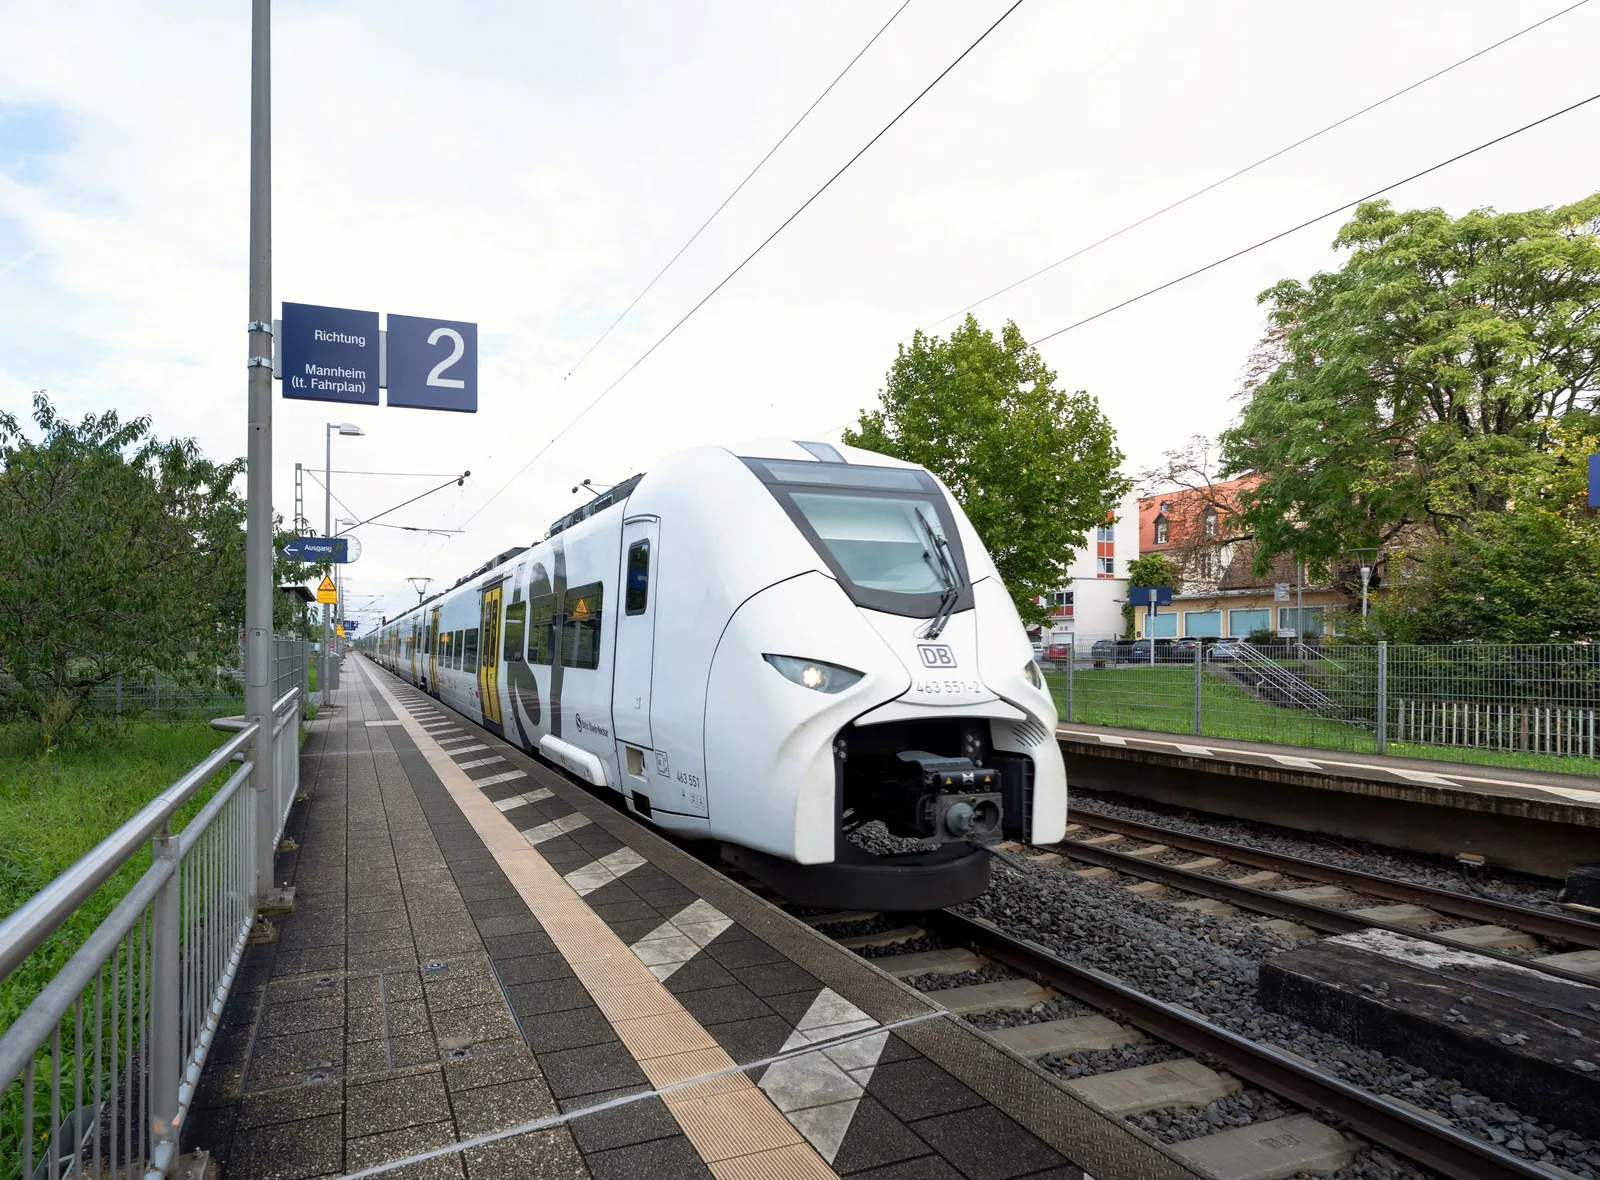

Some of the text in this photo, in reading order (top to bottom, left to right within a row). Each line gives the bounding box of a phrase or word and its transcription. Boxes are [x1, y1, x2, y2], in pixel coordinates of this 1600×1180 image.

[314, 329, 366, 348] Richtung
[426, 327, 465, 389] 2
[305, 363, 366, 379] Mannheim
[291, 375, 366, 394] (lt. Fahrplan)
[304, 544, 332, 552] Ausgang
[922, 648, 952, 664] DB
[917, 681, 981, 693] 463 551-2
[676, 771, 700, 788] 463 551
